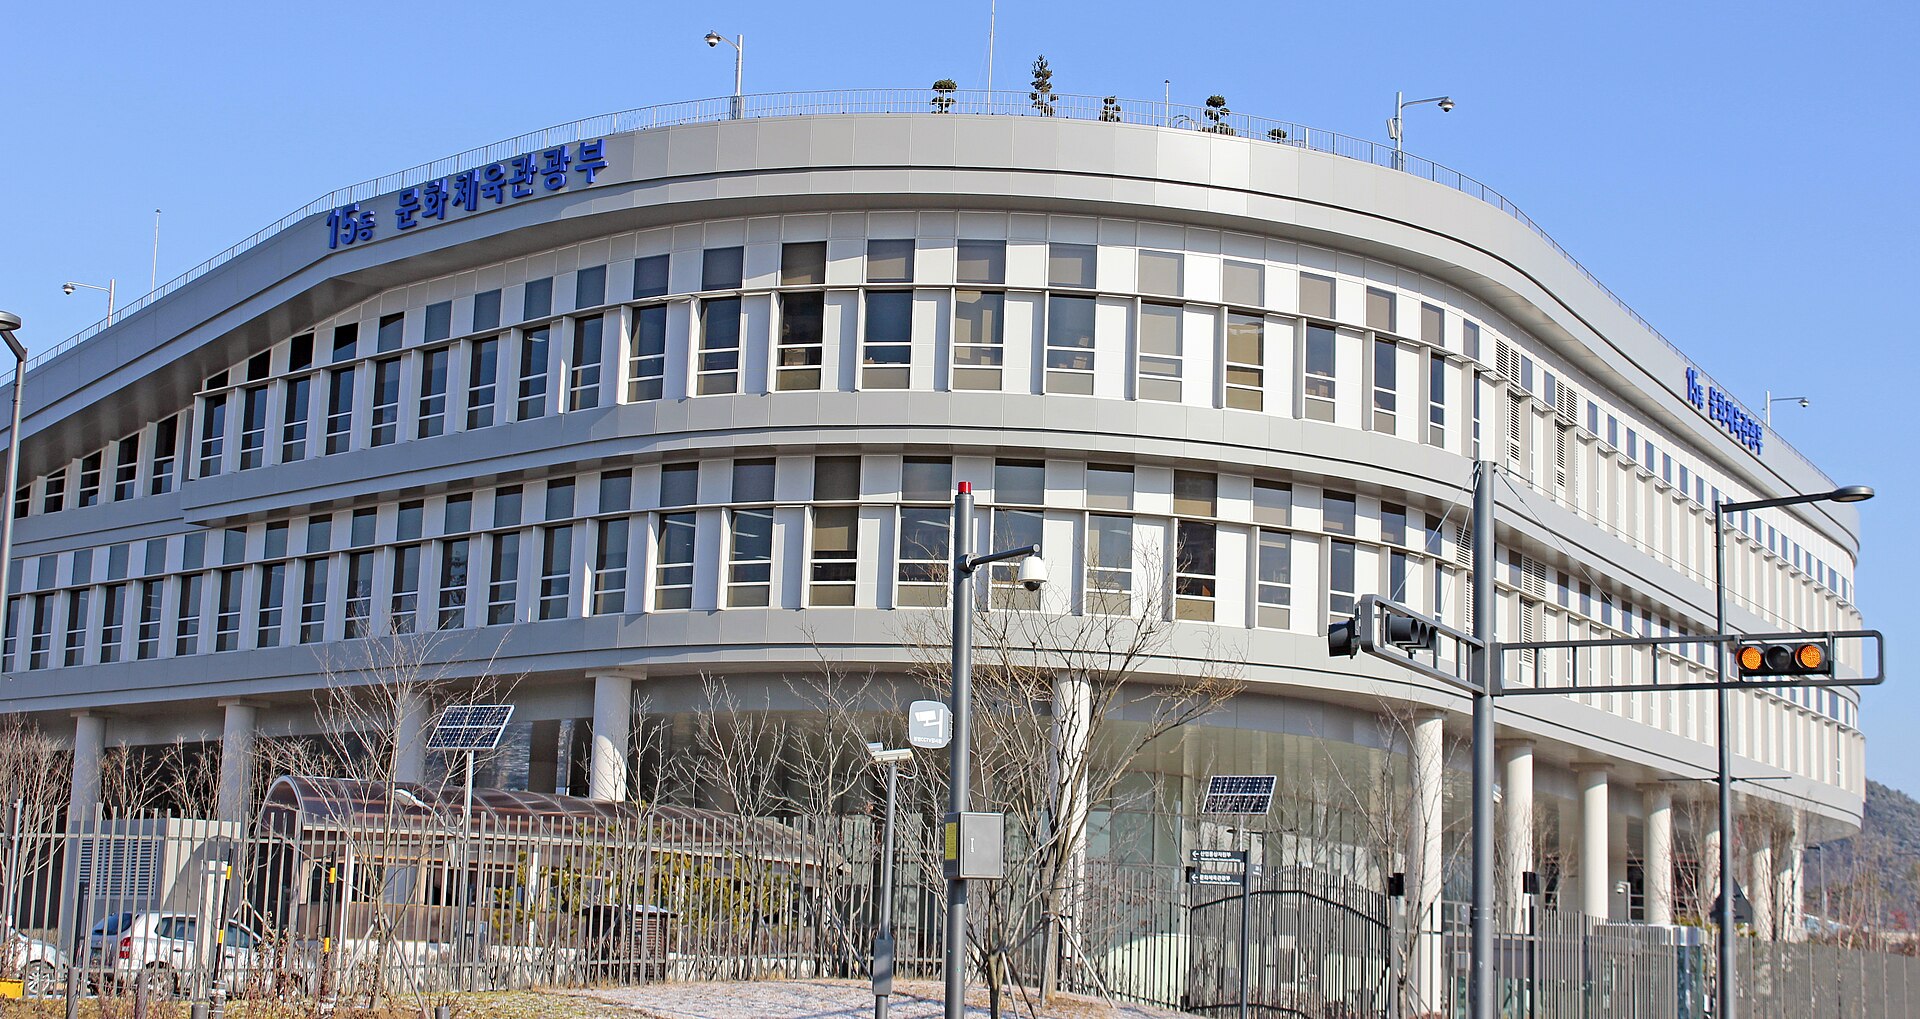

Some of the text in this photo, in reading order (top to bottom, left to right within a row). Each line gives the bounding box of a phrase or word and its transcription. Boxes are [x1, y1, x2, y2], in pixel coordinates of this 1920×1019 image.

[326, 138, 609, 249] 15동 문화체육관광부
[1708, 386, 1763, 456] 문화체육관광부
